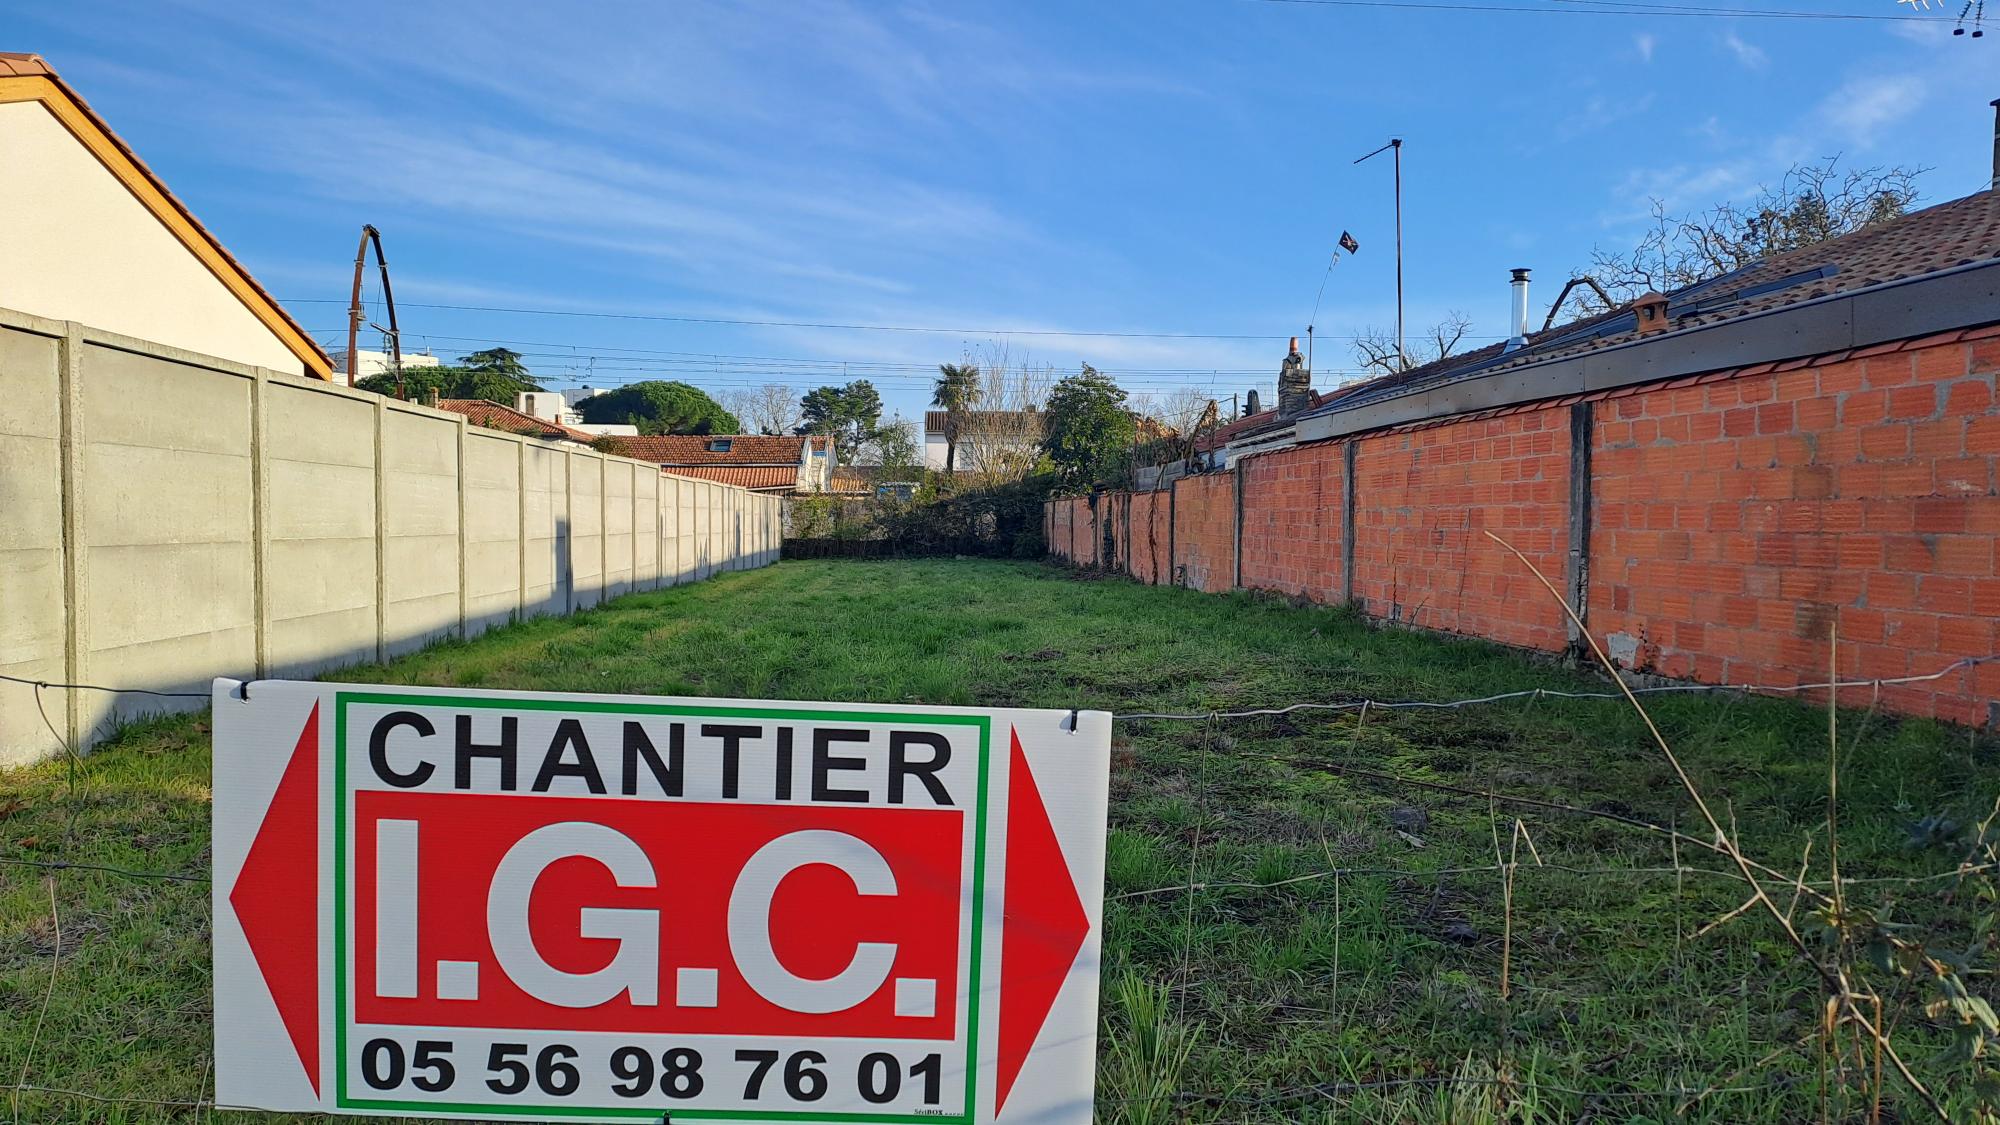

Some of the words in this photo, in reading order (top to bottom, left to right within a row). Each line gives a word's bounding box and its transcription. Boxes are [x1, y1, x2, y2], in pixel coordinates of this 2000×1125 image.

[367, 709, 956, 807] CHANTIER
[374, 817, 938, 1019] I.G.C.
[361, 1036, 456, 1093] 05
[485, 1042, 582, 1097] 56
[608, 1046, 704, 1100] 98
[734, 1049, 828, 1102] 76
[857, 1052, 943, 1105] 01
